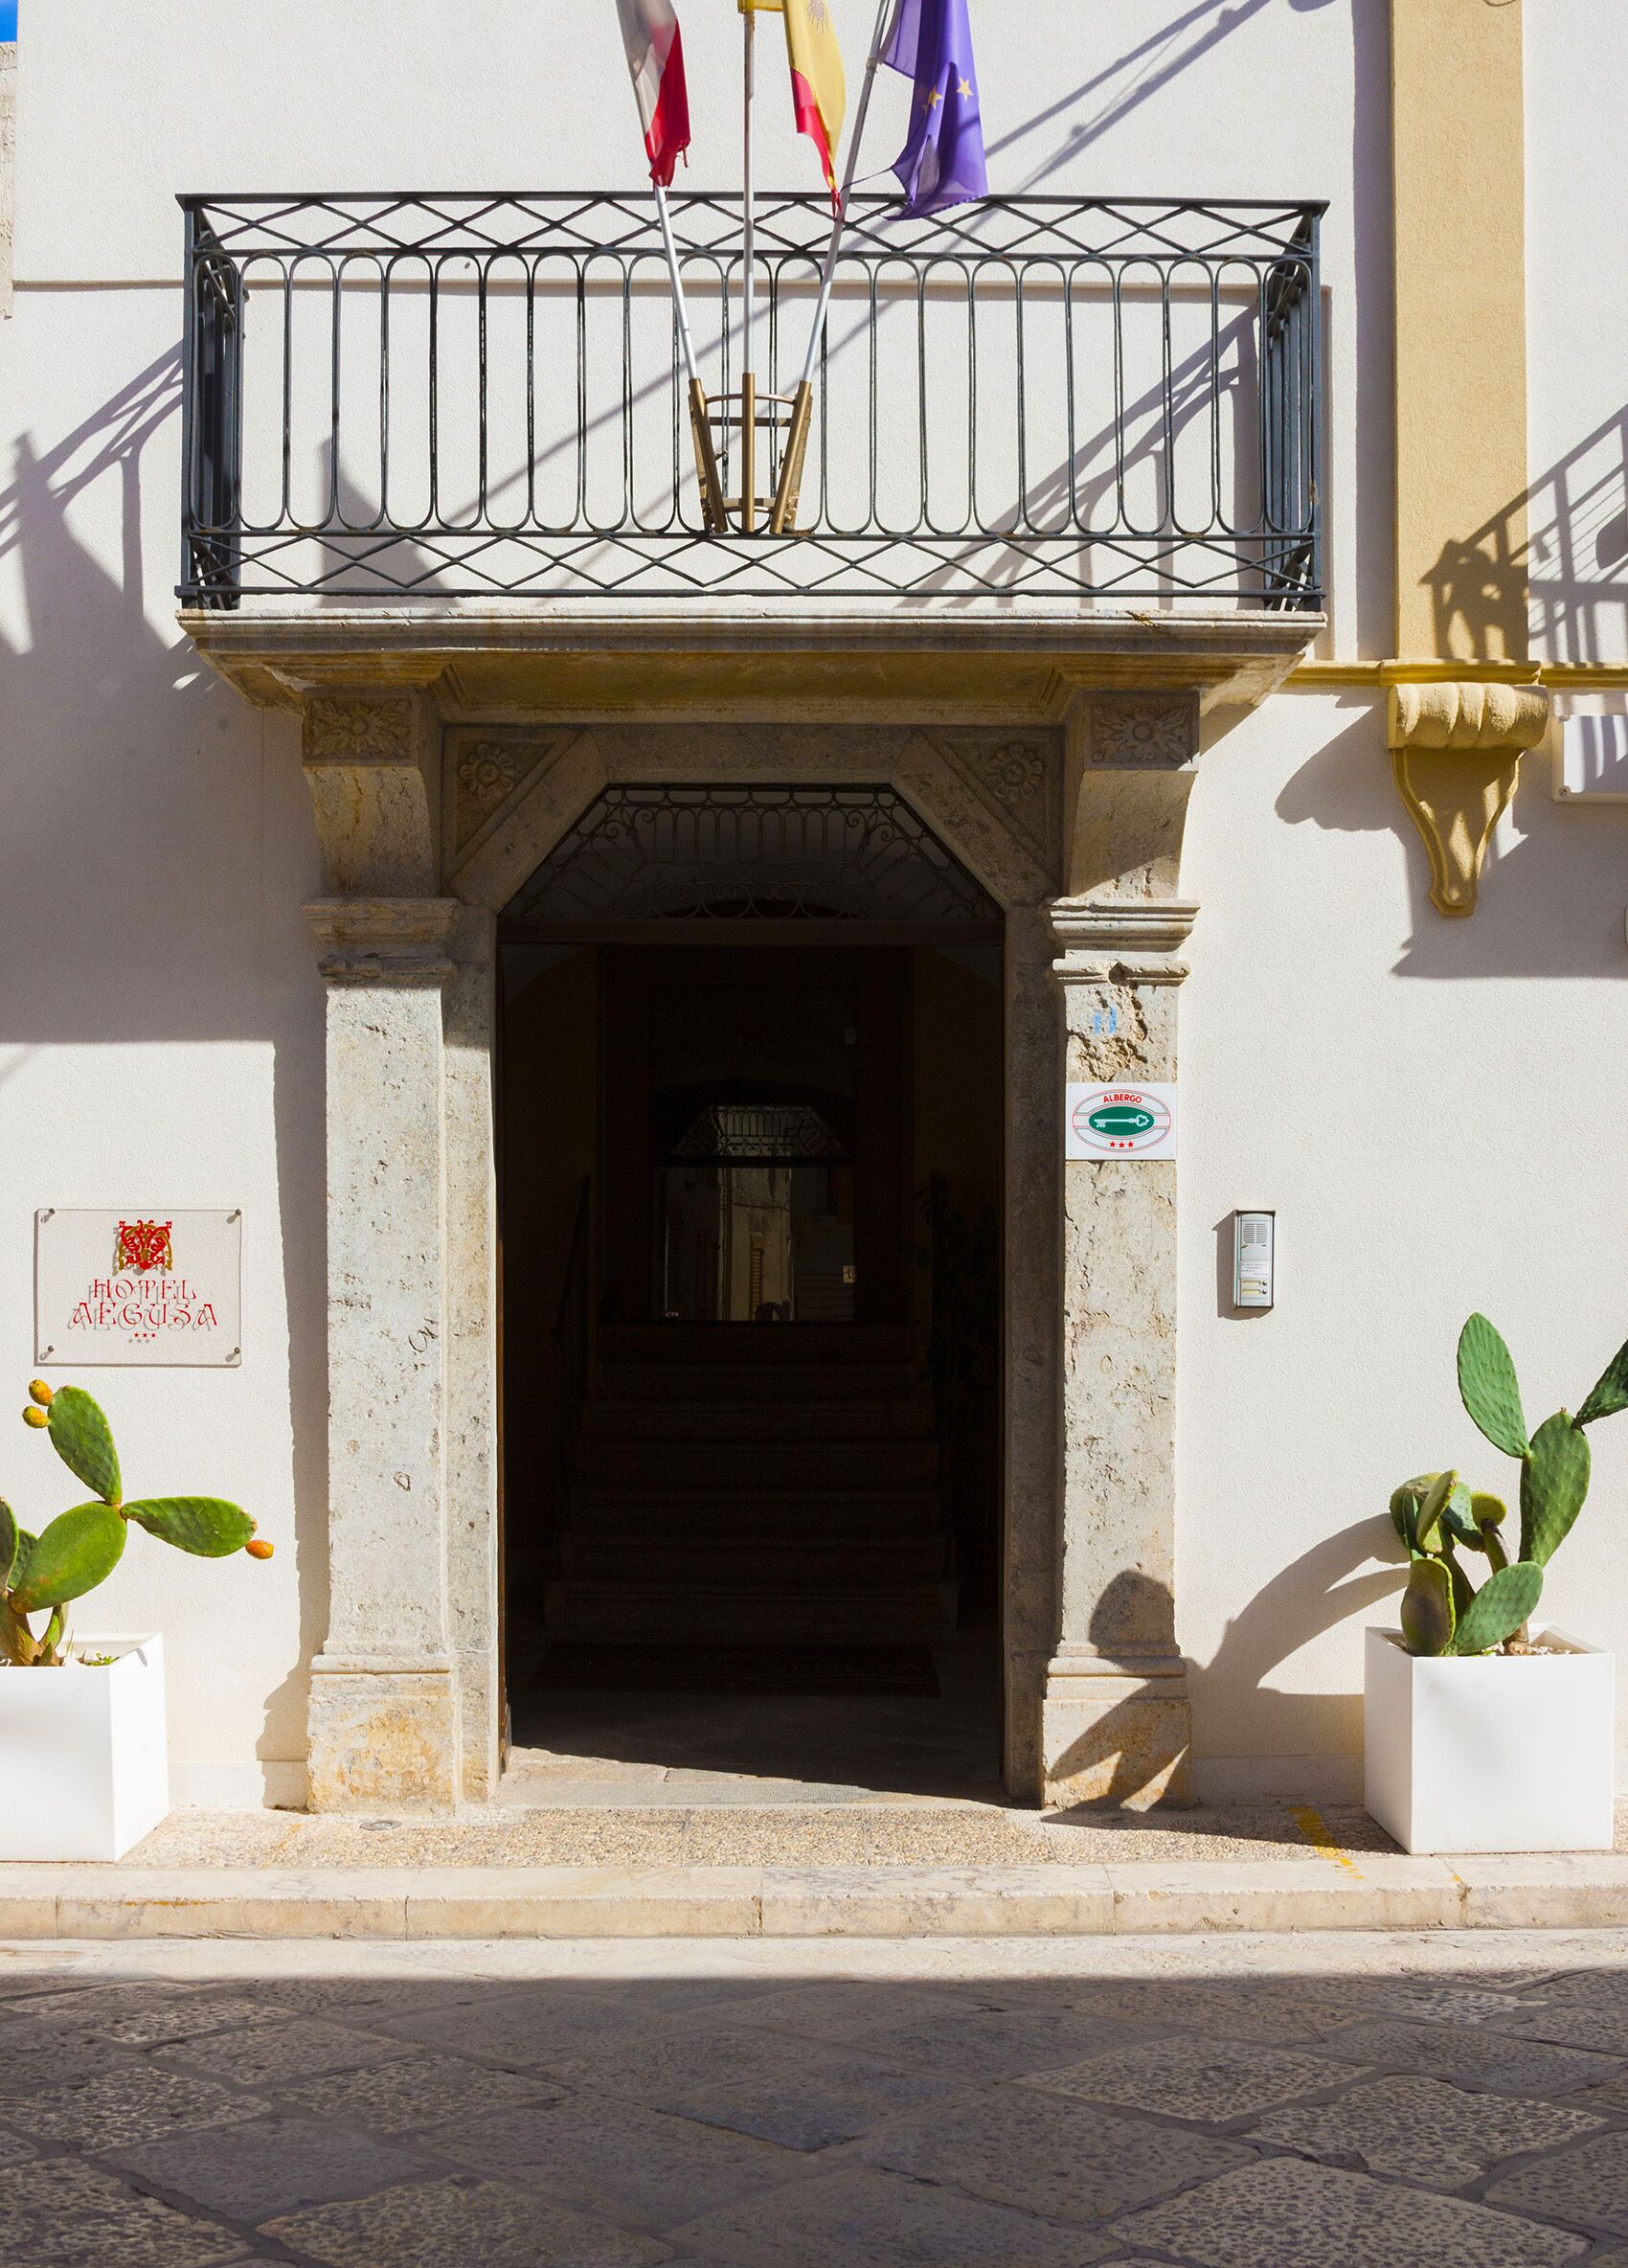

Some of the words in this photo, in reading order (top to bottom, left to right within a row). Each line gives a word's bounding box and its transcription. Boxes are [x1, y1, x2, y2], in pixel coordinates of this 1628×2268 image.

[1103, 1093, 1142, 1103] ALBERGO
[94, 1279, 196, 1299] HOTEL
[73, 1303, 217, 1326] AEGUSA
